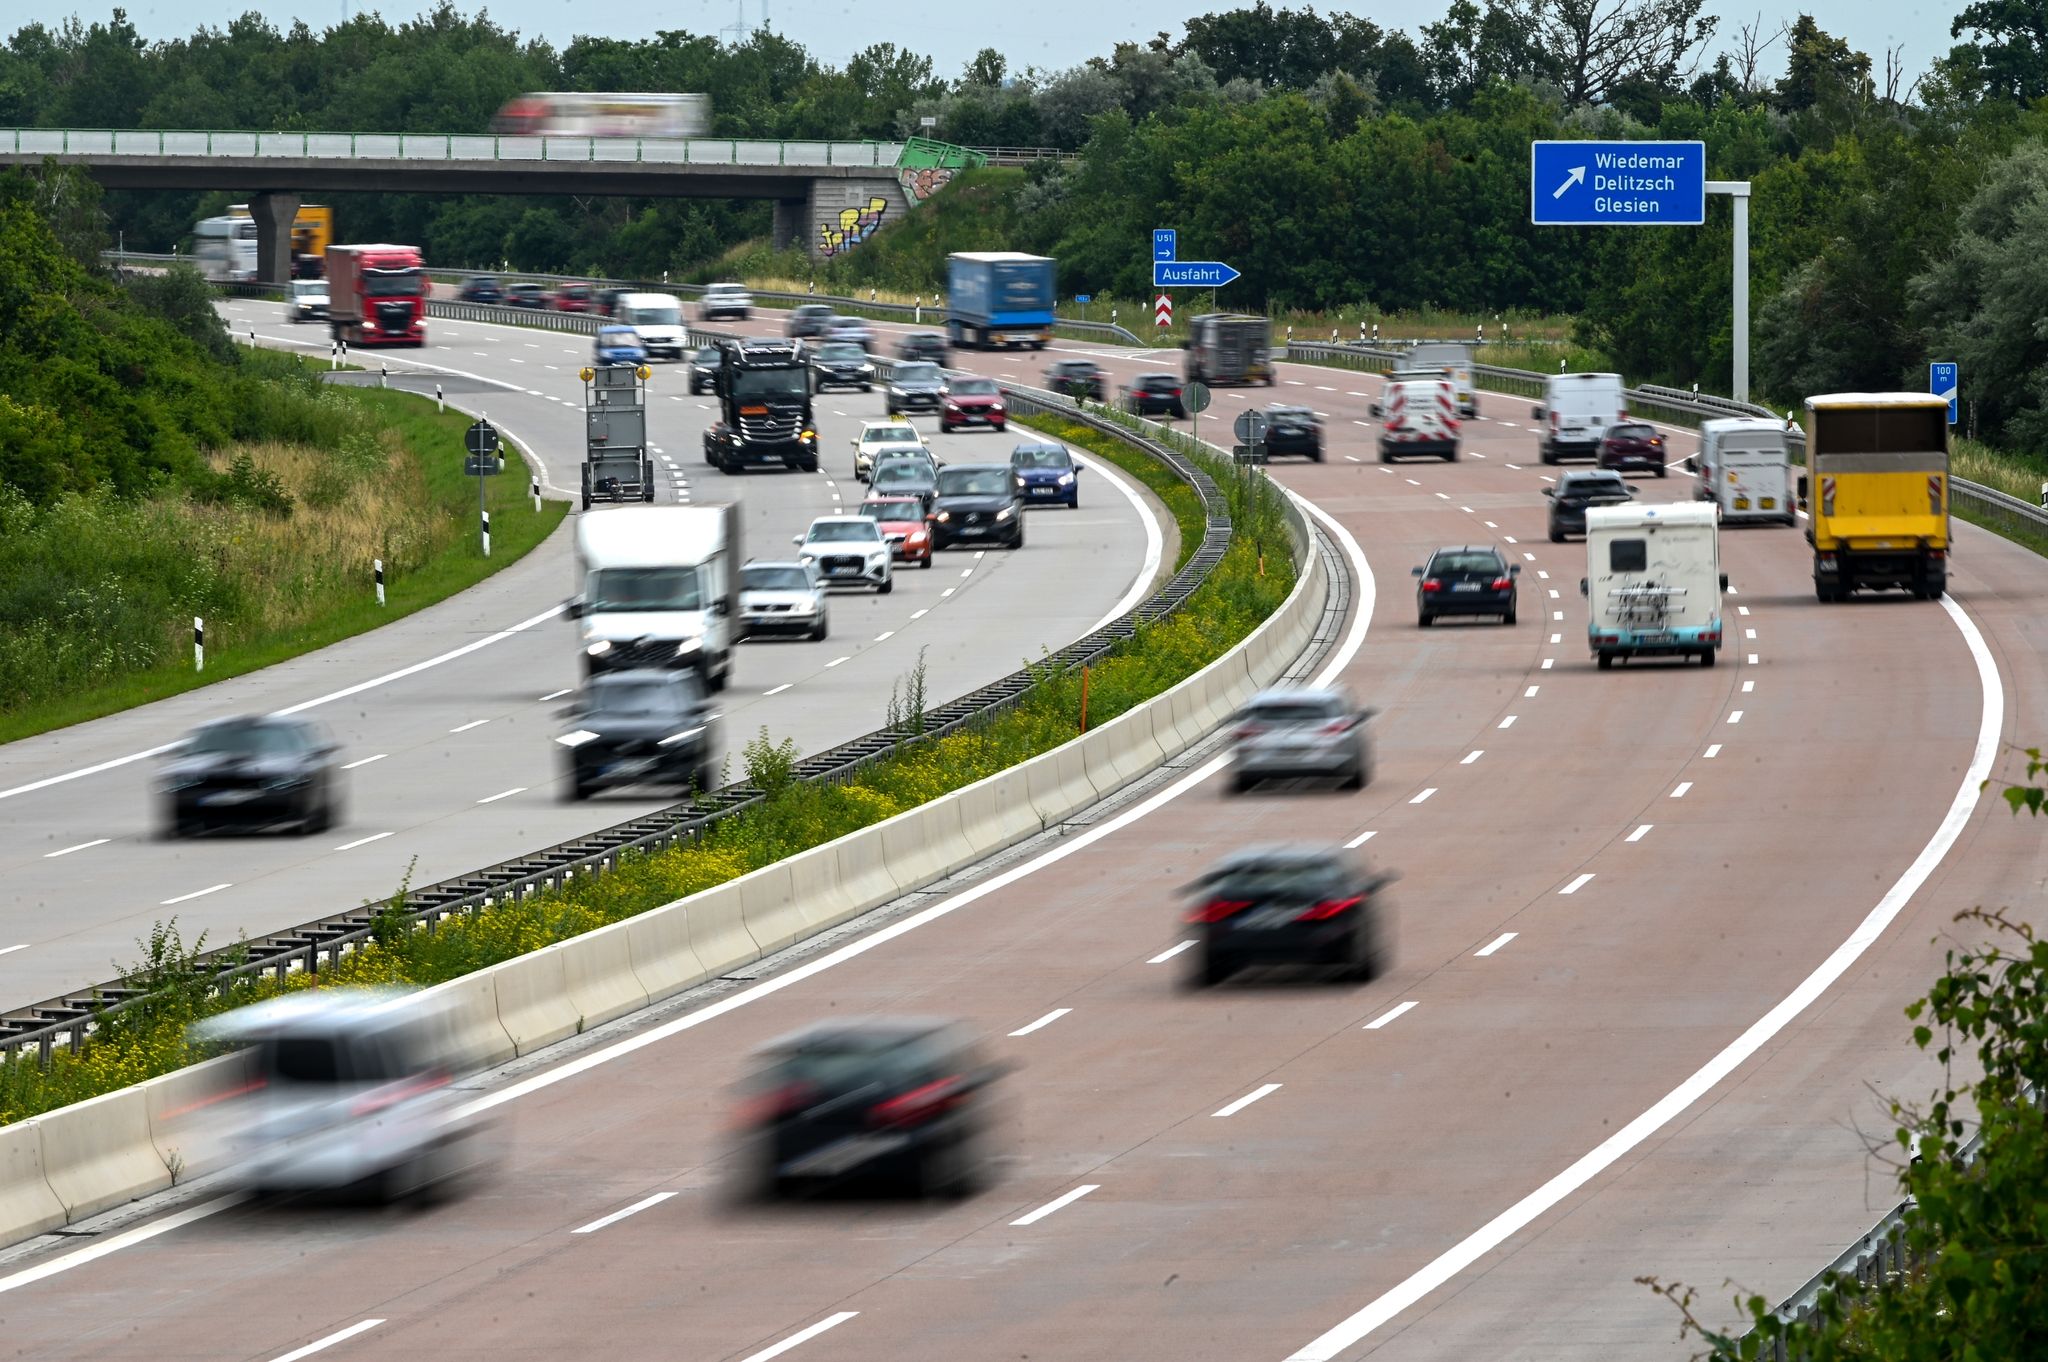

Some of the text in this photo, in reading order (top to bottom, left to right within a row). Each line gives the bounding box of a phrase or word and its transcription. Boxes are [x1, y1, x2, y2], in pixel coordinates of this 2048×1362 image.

[1595, 153, 1684, 169] Wiedemar
[1594, 175, 1675, 191] Delitzsch
[1594, 197, 1659, 213] Glesien
[1162, 268, 1220, 281] Ausfahrt
[1936, 366, 1951, 375] 100
